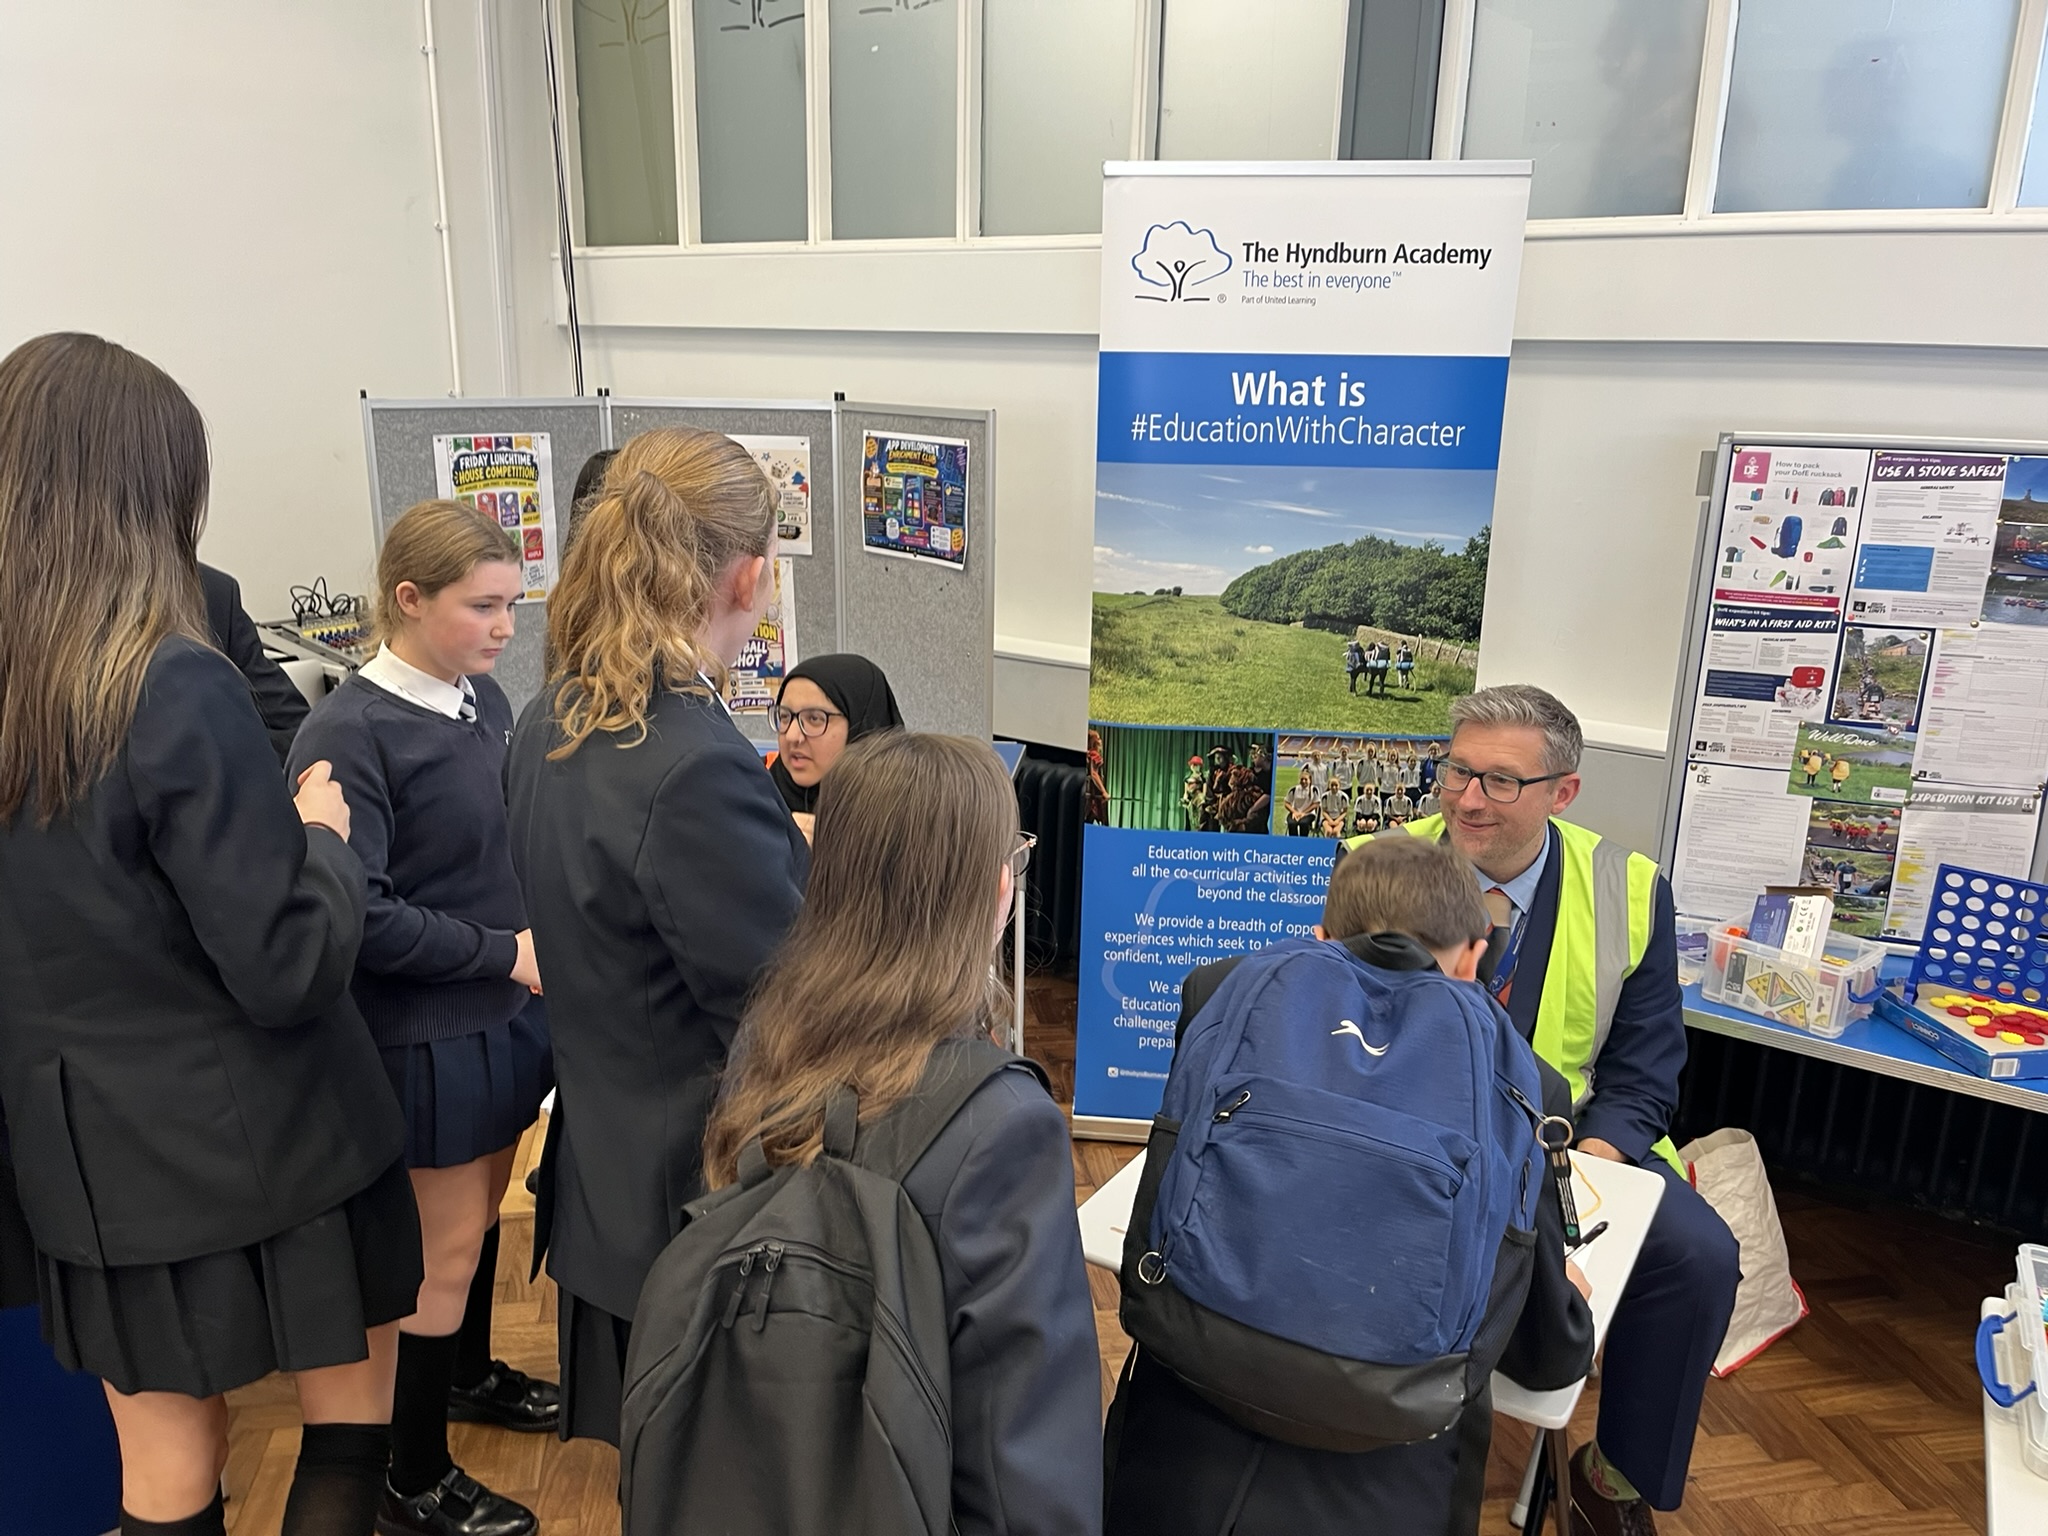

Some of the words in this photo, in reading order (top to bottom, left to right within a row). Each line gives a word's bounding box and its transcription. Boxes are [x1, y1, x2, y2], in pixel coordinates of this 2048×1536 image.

[1242, 242, 1279, 263] The
[1285, 243, 1387, 269] Hyndburn
[1393, 244, 1492, 270] Academy
[1242, 270, 1270, 288] The
[1273, 271, 1304, 289] best
[1308, 272, 1321, 289] in
[1241, 295, 1254, 304] Part
[1255, 295, 1263, 304] of
[1264, 295, 1286, 305] United
[1287, 296, 1317, 306] Learning
[1231, 370, 1327, 406] What
[1339, 372, 1366, 407] is
[1130, 413, 1466, 447] #EducationWithCharacter
[885, 439, 900, 452] APP
[900, 440, 940, 456] DEVELOPMENT
[460, 453, 488, 470] FRIDAY
[490, 452, 532, 467] LUNCHTIME
[1802, 462, 1821, 470] pack
[459, 467, 485, 485] HOUSE
[485, 465, 536, 480] COMPETITION
[1791, 469, 1809, 477] DofE
[1876, 465, 1904, 478] USE
[1905, 465, 1916, 478] A
[1918, 465, 1958, 477] STOVE
[1959, 464, 2006, 478] SAFELY
[1714, 617, 1747, 627] WHAT'S
[1748, 618, 1760, 628] IN
[1760, 618, 1769, 628] A
[1768, 619, 1793, 628] FIRST
[1794, 619, 1813, 629] AID
[1813, 620, 1837, 629] KIT?
[1807, 729, 1843, 744] Well
[1842, 733, 1880, 746] Done
[1910, 792, 1975, 804] EXPEDITION
[1975, 795, 1996, 805] KIT
[1996, 796, 2020, 806] LIST
[1148, 845, 1209, 861] Education
[1212, 847, 1240, 863] with
[1243, 849, 1303, 867] Character
[1132, 863, 1147, 877] all
[1150, 864, 1170, 878] the
[1173, 866, 1250, 882] co-curricular
[1253, 869, 1308, 885] activities
[1197, 885, 1242, 902] beyond
[1246, 888, 1266, 902] the
[1134, 913, 1155, 927] We
[1158, 914, 1204, 930] provide
[1207, 919, 1215, 930] a
[1218, 916, 1266, 932] breadth
[1269, 919, 1283, 934] of
[1104, 932, 1175, 947] experiences
[1178, 934, 1214, 949] which
[1217, 935, 1245, 950] seek
[1248, 937, 1262, 951] to
[1103, 949, 1163, 965] confident,
[1149, 980, 1169, 994] We
[1121, 996, 1180, 1012] Education
[1113, 1014, 1176, 1031] challenges
